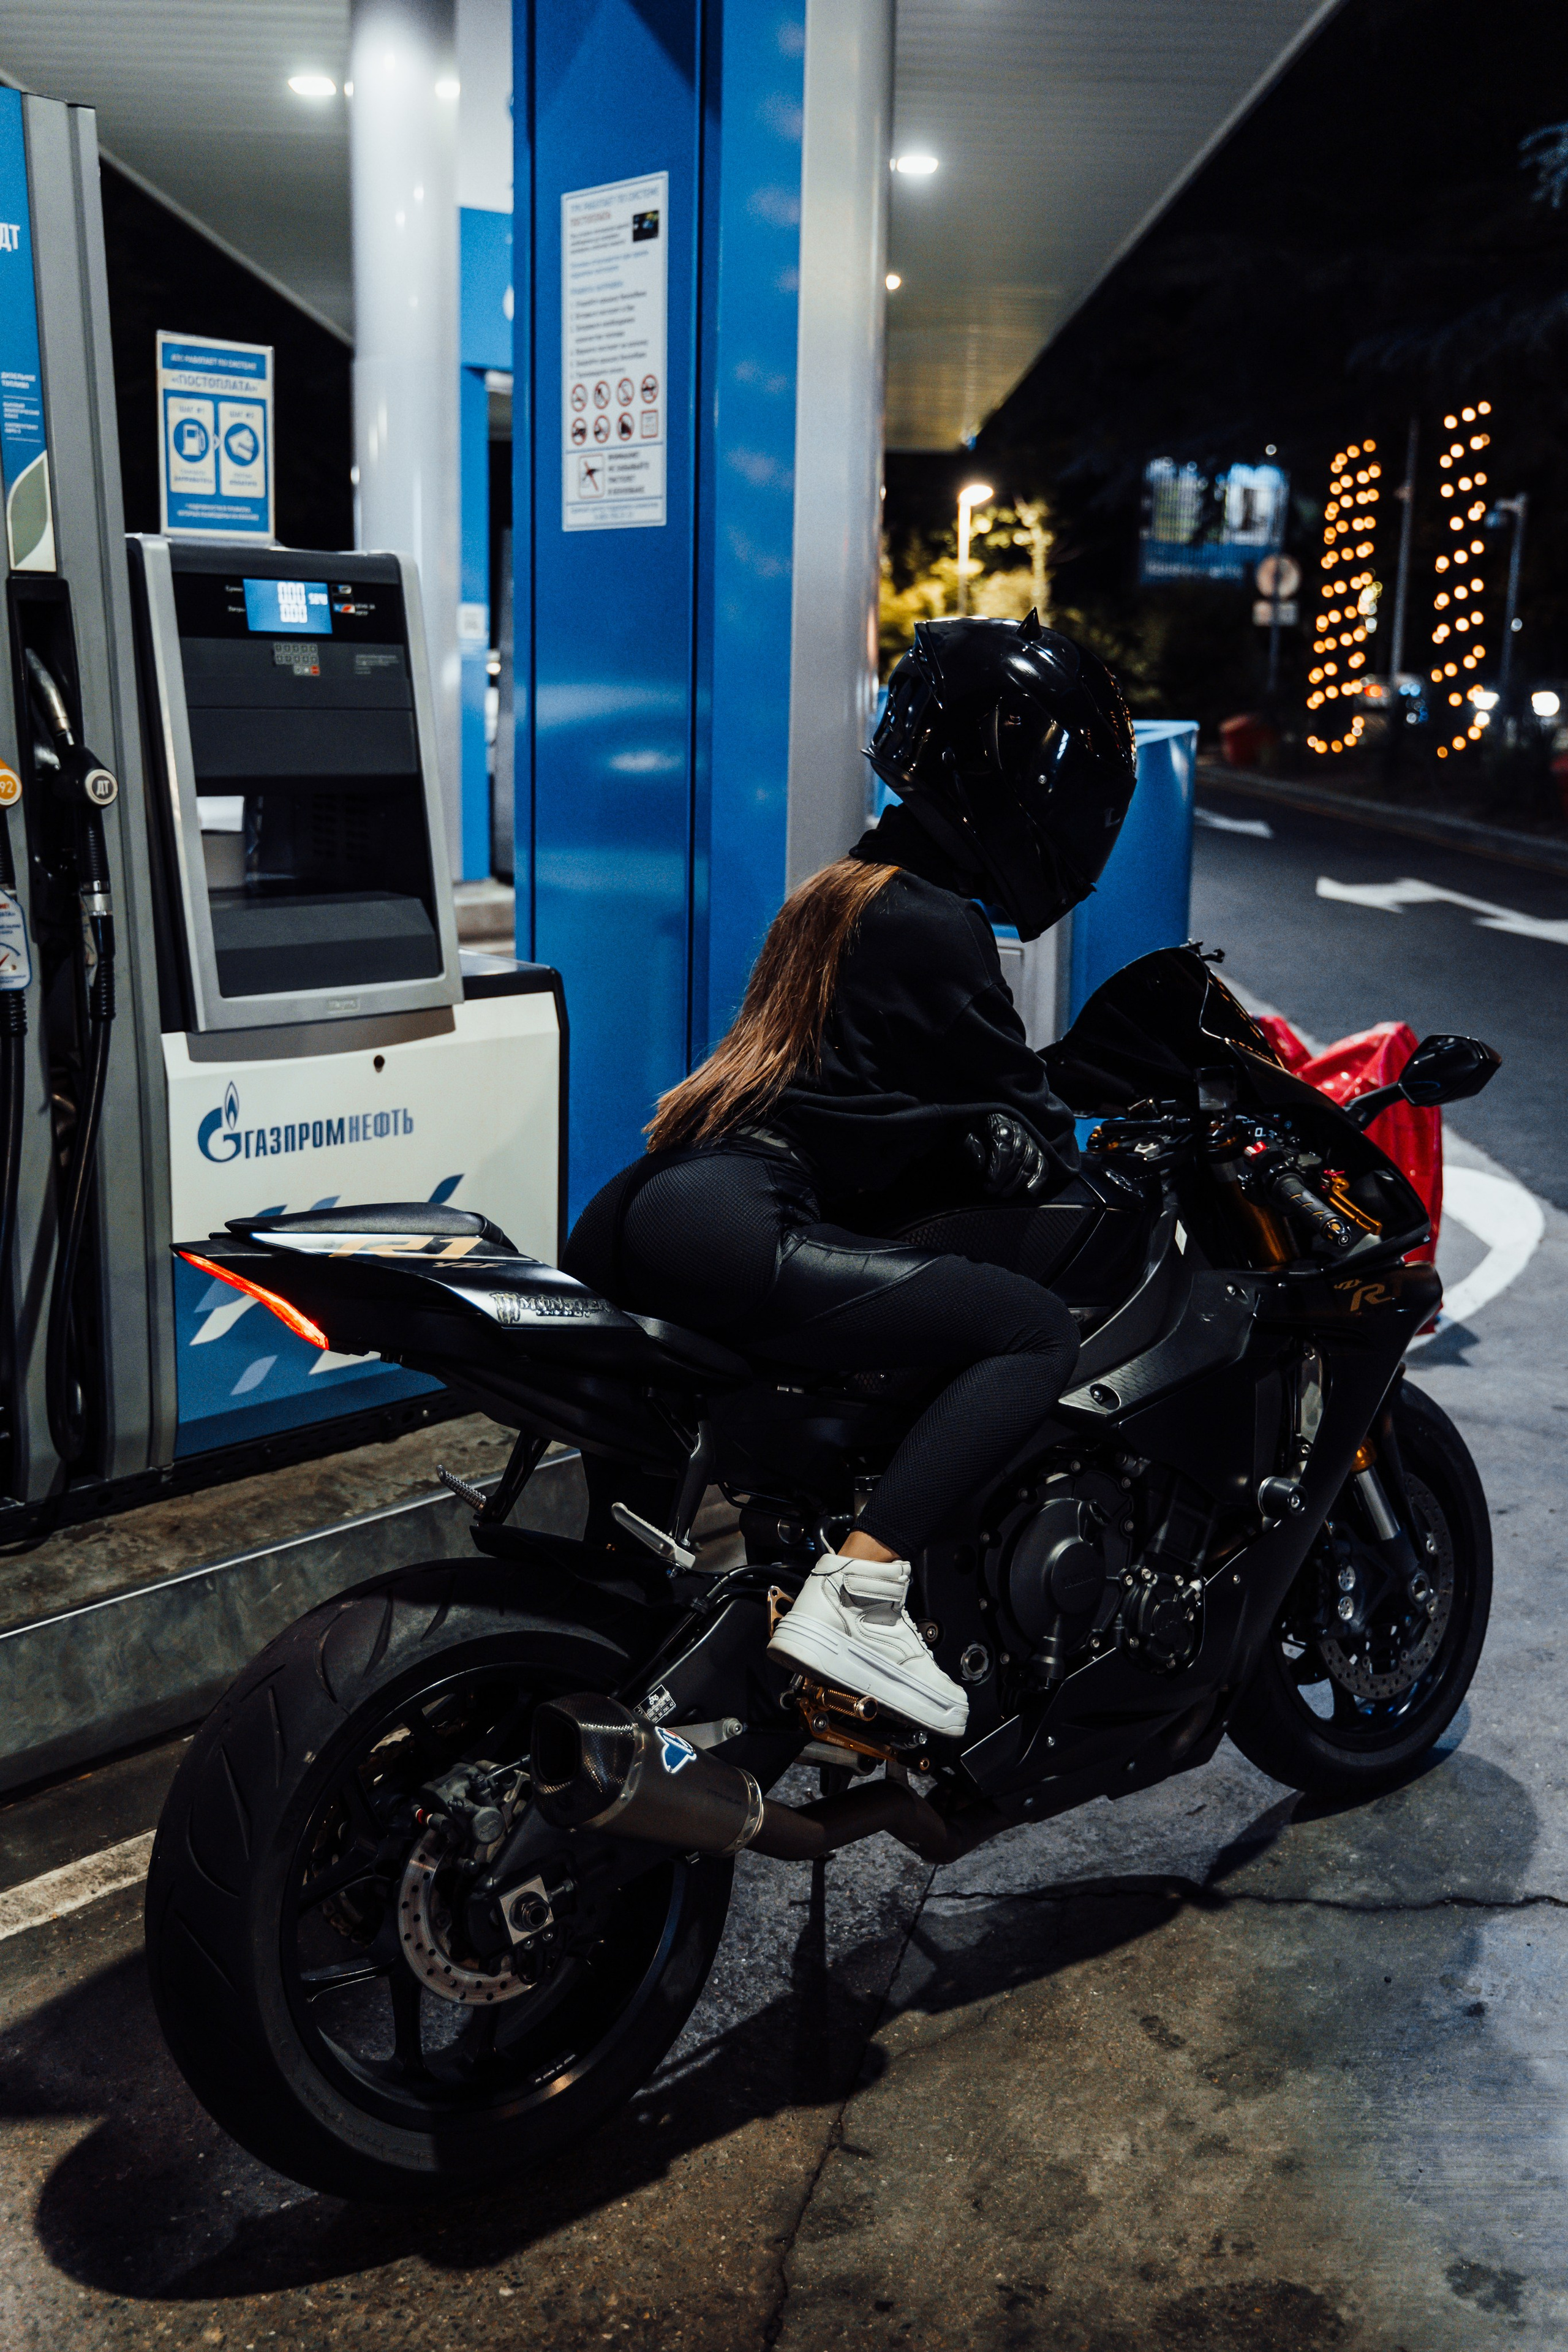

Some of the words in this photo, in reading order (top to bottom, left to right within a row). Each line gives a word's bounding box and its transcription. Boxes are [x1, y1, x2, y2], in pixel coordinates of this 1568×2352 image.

[0, 222, 20, 252] ДТ
[0, 781, 13, 793] 92
[96, 780, 110, 796] ДТ
[245, 1108, 413, 1159] ГАЗПРОМНЕФТЬ
[328, 1236, 483, 1259] R1
